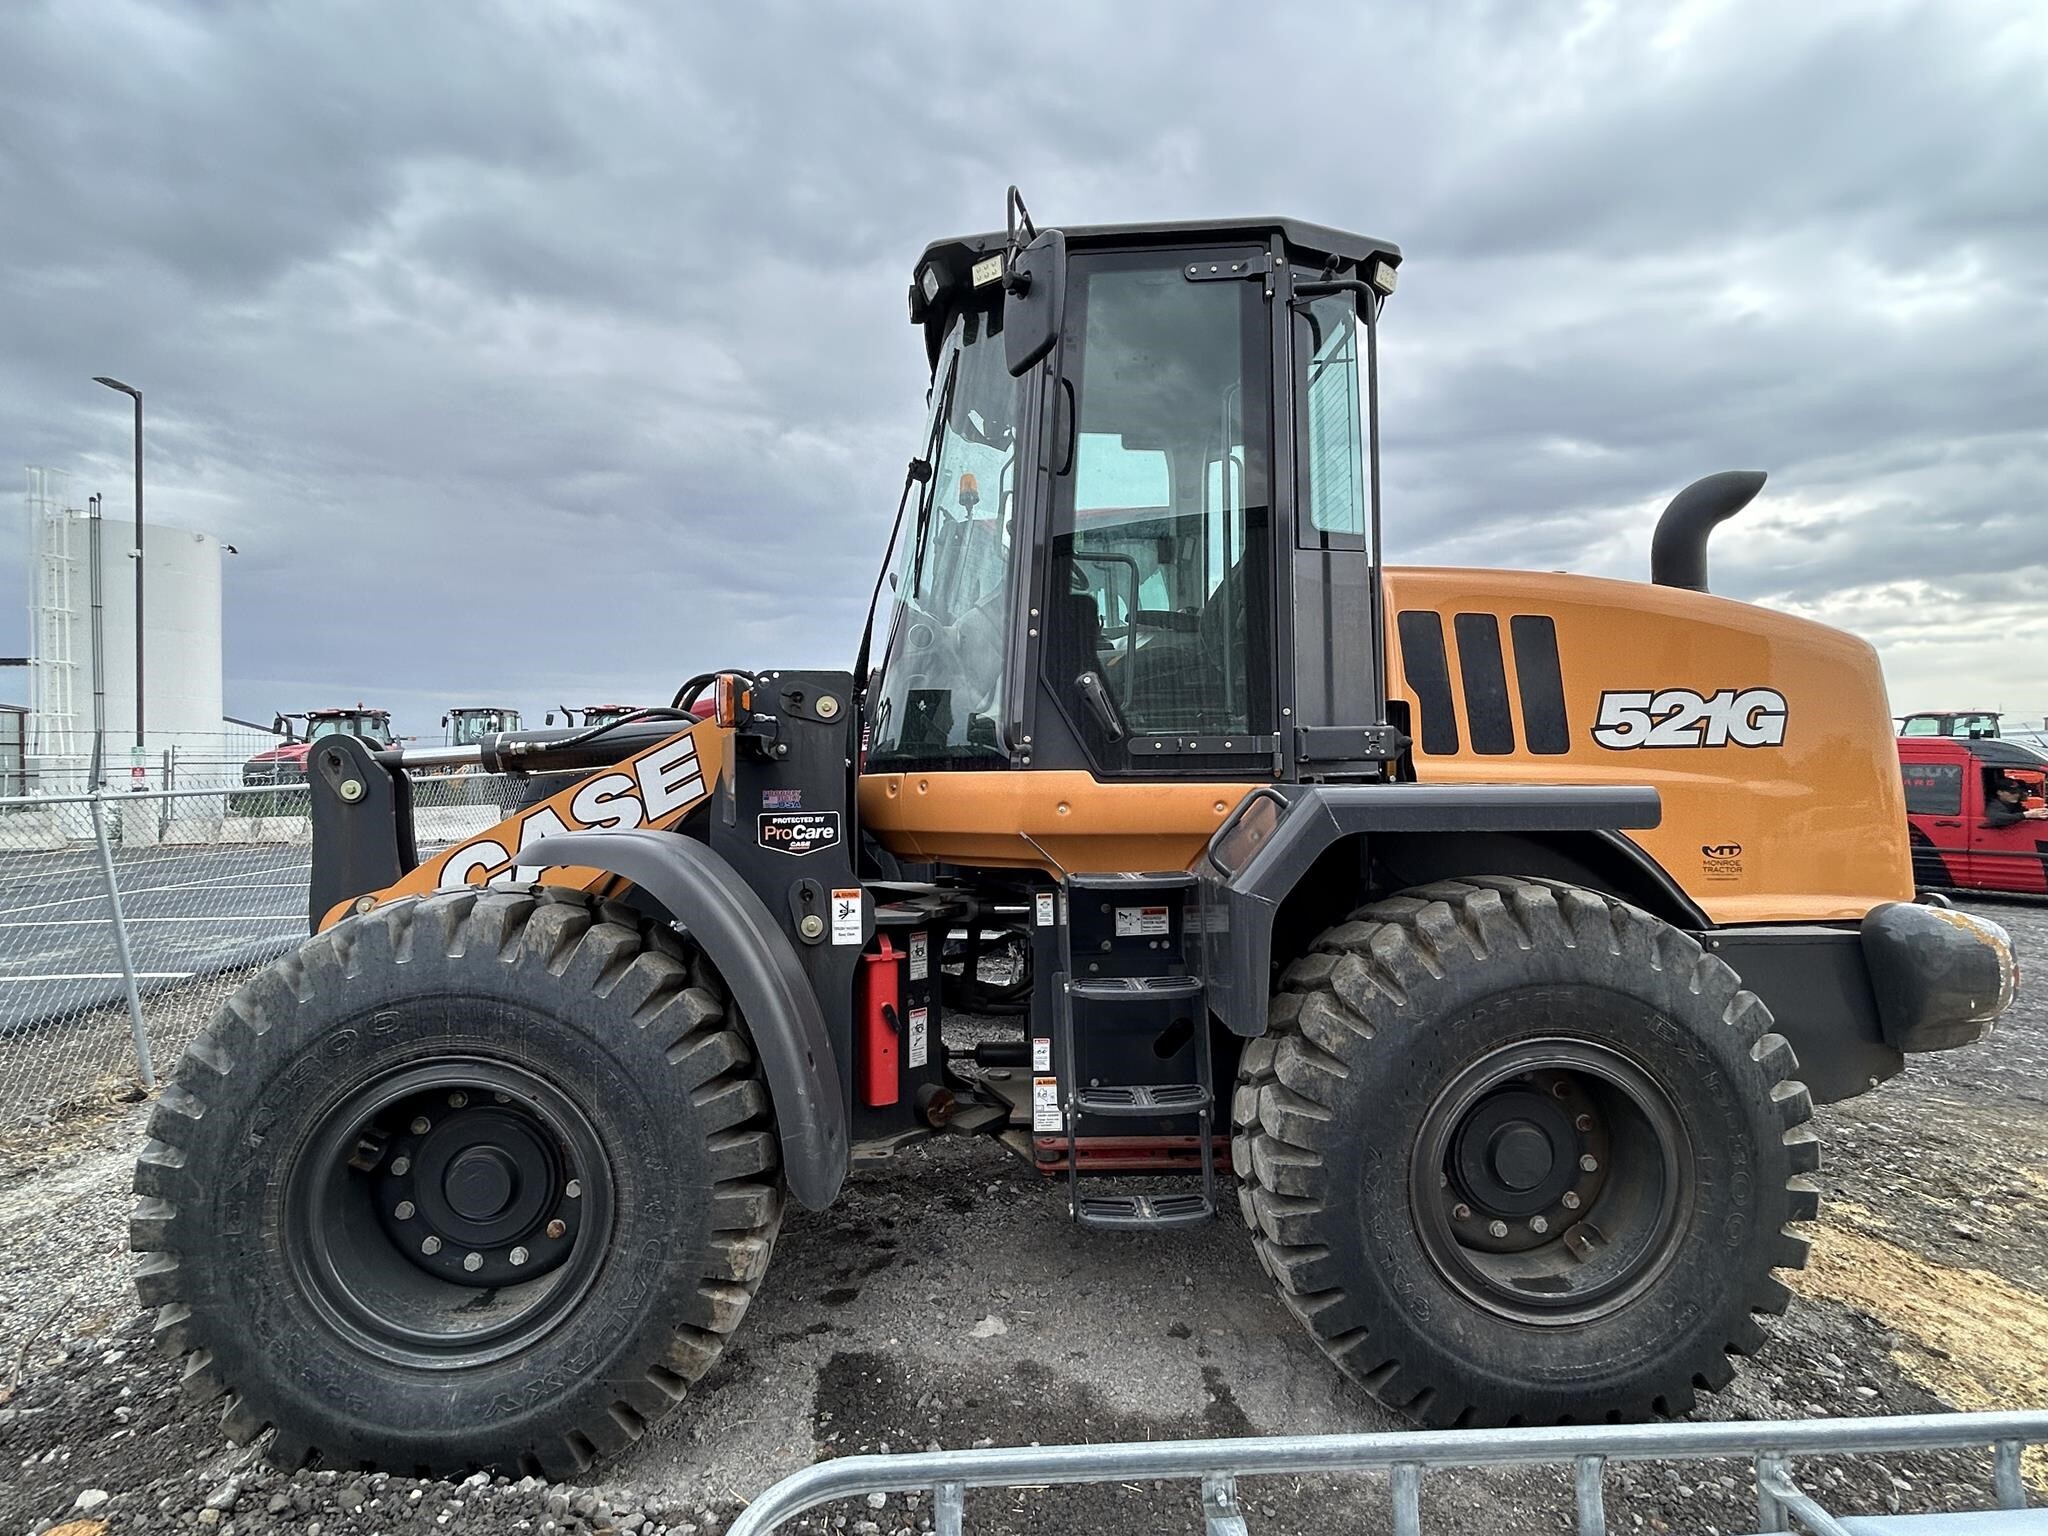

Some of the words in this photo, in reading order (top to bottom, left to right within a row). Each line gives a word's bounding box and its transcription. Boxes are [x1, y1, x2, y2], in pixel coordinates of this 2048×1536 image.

[1591, 687, 1788, 750] 521G
[772, 816, 814, 824] PROTECTED
[764, 824, 834, 840] ProCare
